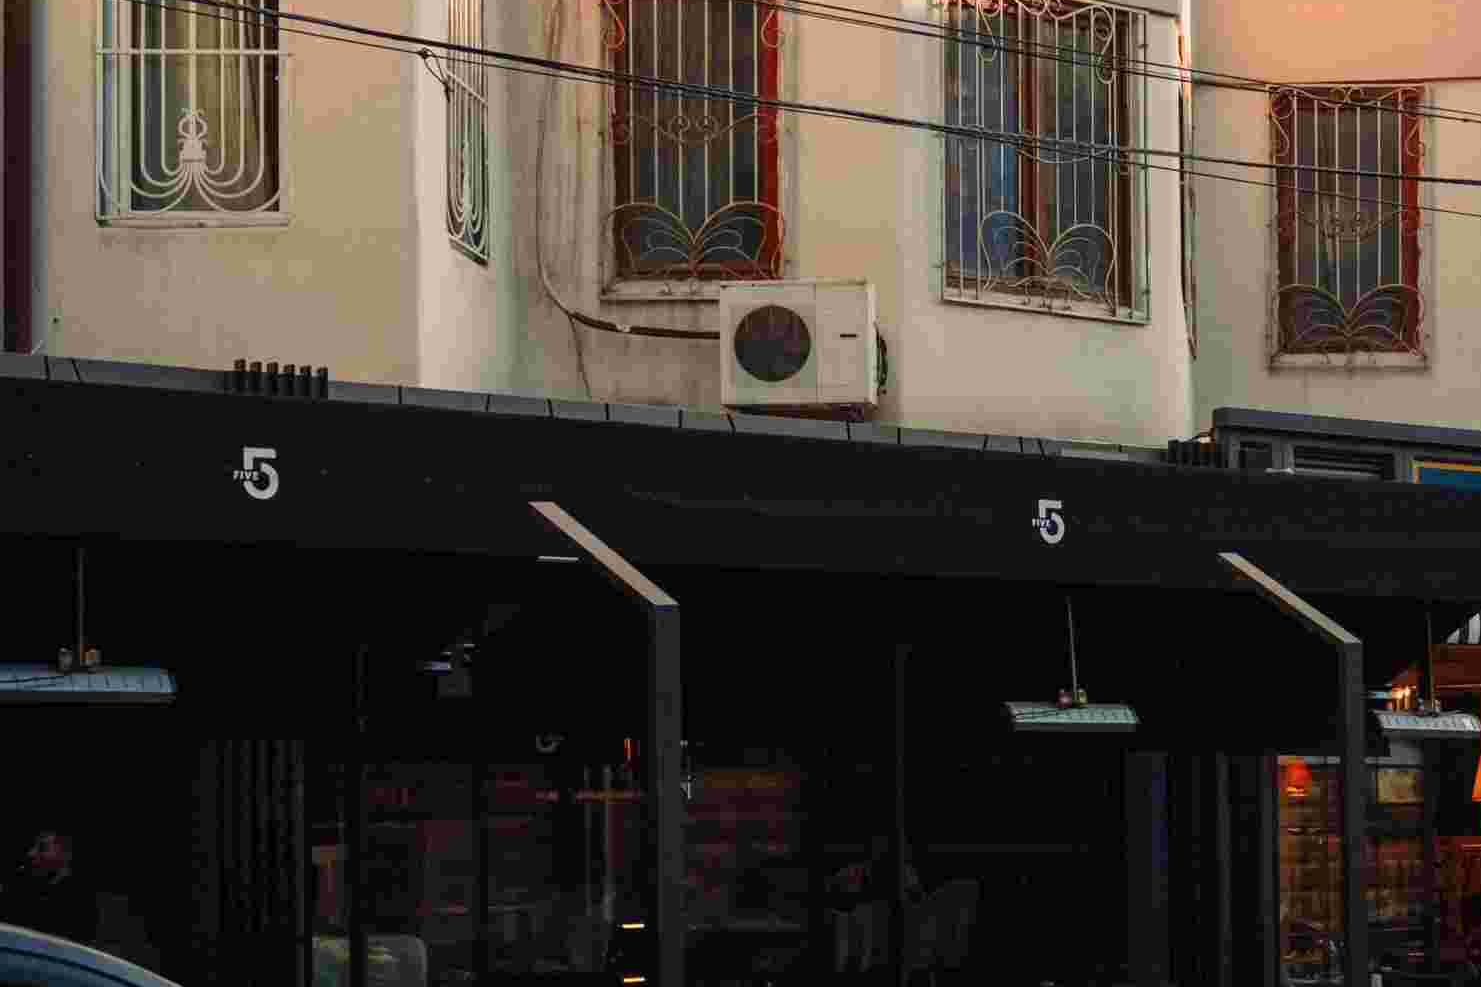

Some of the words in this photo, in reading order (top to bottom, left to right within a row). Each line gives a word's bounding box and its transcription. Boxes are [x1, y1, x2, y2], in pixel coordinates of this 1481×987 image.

[233, 470, 260, 481] FIVE
[243, 446, 279, 500] 5
[1038, 499, 1065, 545] 5
